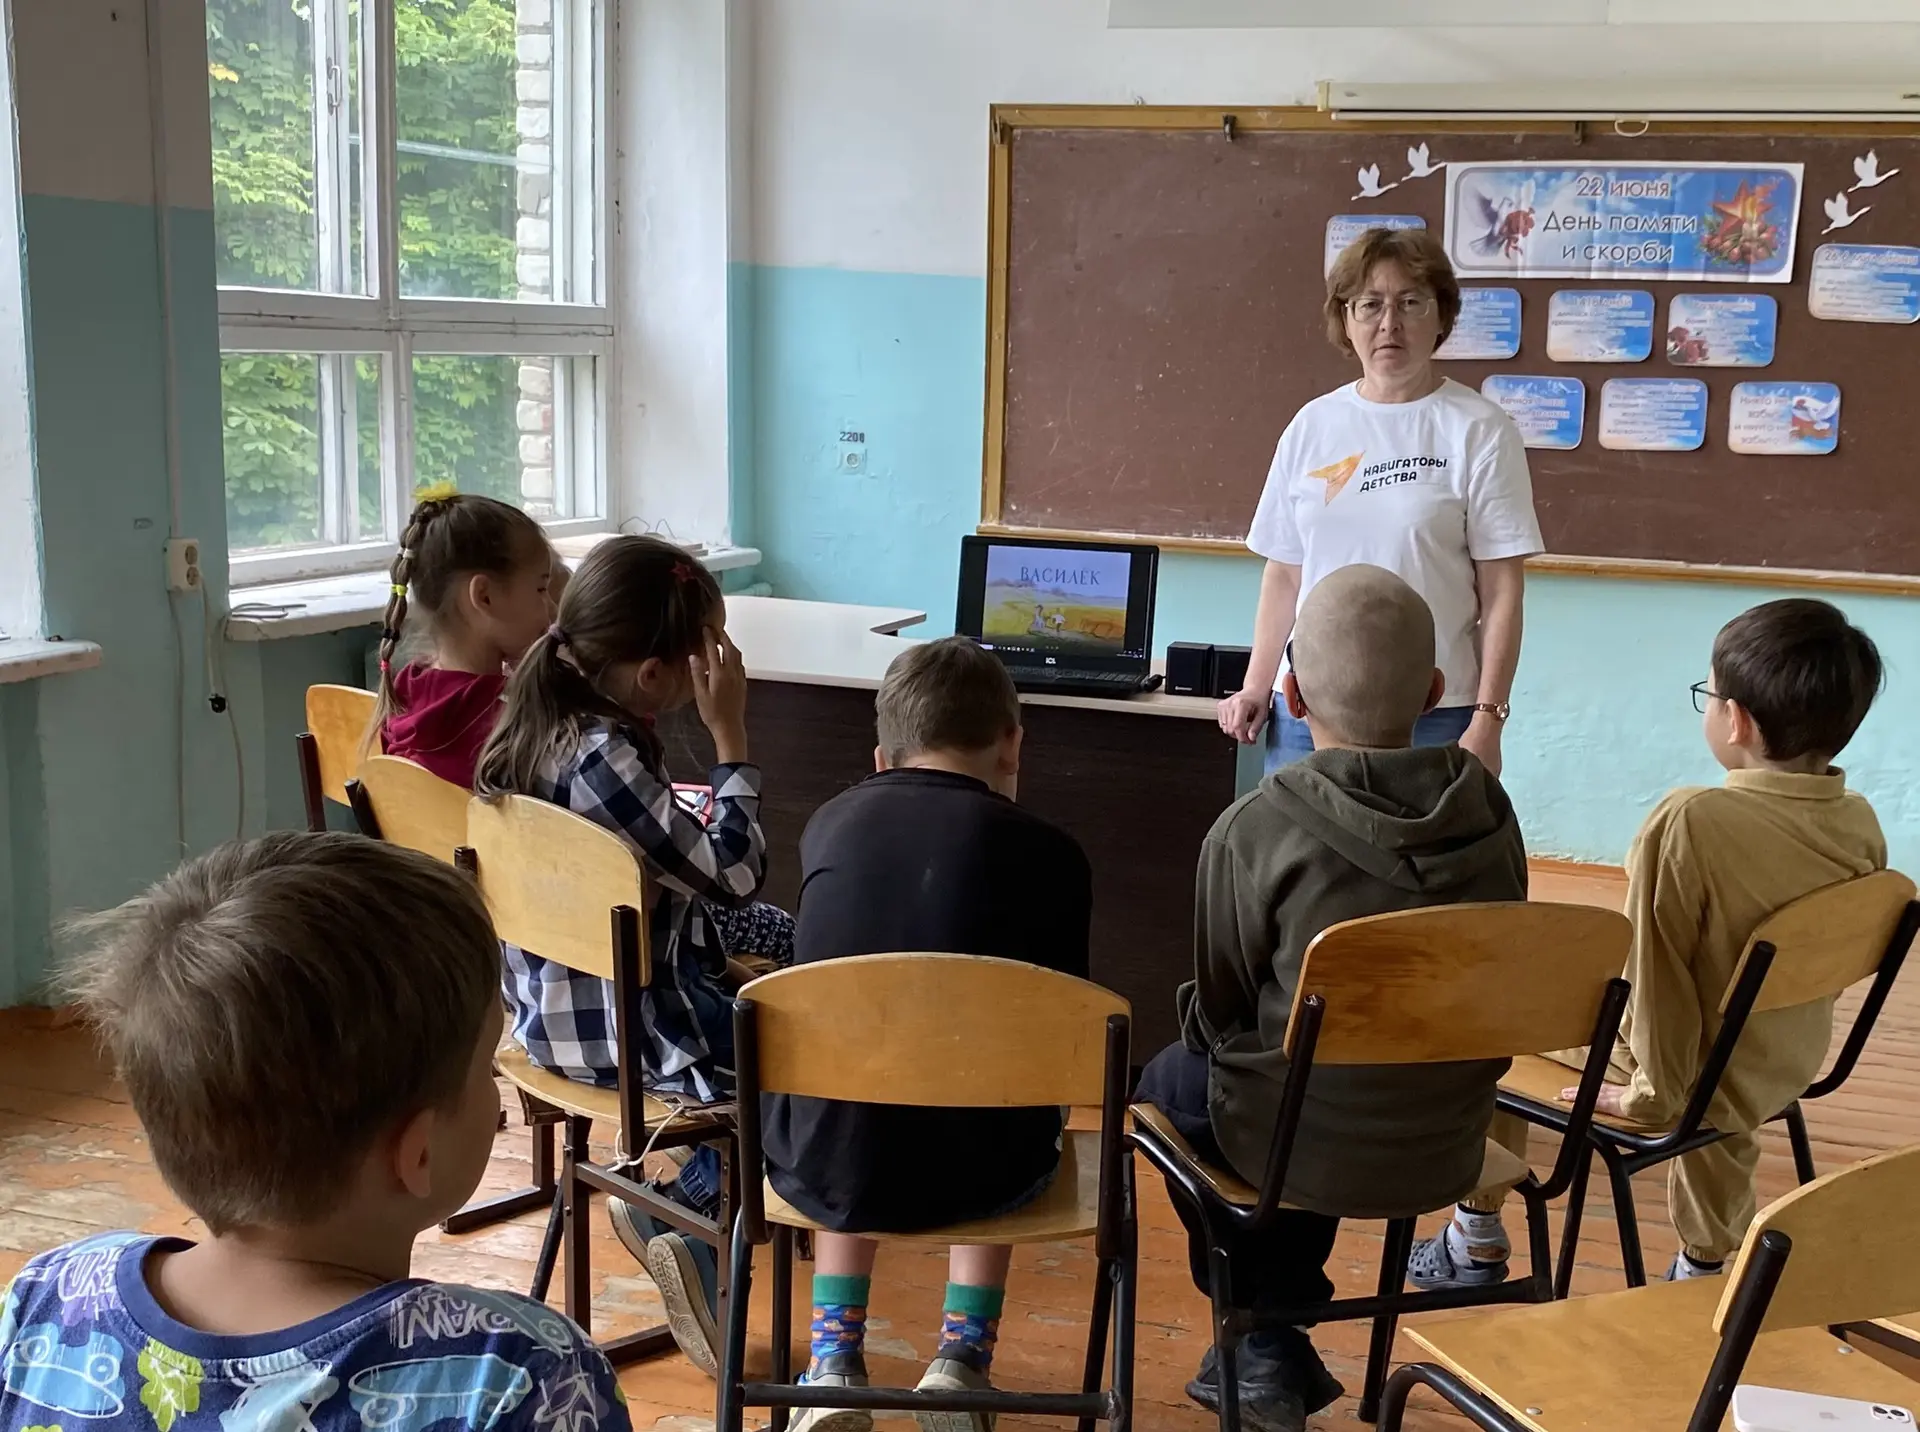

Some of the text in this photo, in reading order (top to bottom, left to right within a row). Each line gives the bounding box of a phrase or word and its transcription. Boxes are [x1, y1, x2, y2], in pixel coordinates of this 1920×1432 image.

[1576, 177, 1670, 198] 22 июня
[1543, 210, 1698, 233] День памяти
[1562, 241, 1673, 267] и скорби
[1363, 456, 1448, 478] НАВИГАТОРЫ
[1360, 471, 1418, 493] ДЕТСТВА
